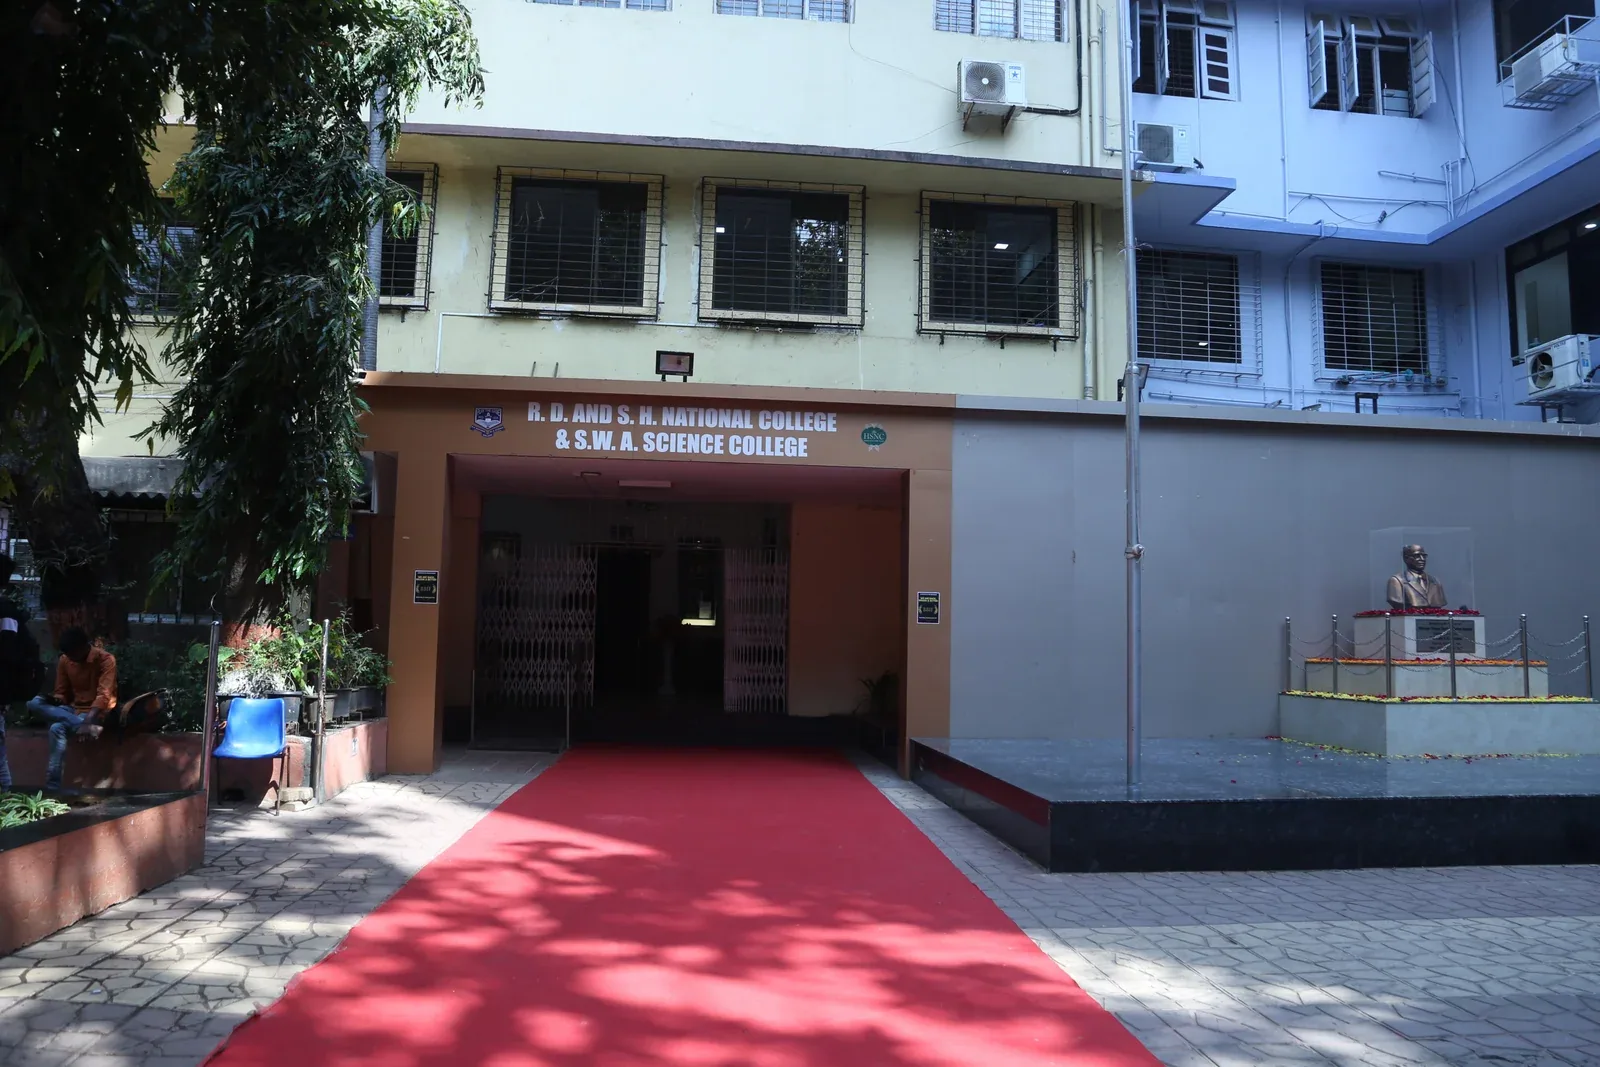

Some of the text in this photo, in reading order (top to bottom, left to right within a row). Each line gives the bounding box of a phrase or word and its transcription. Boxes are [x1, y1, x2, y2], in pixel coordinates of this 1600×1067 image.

[527, 401, 838, 432] R. D. AND S. H. NATIONAL COLLEGE
[555, 428, 808, 458] & S.W. A. SCIENCE COLLEGE
